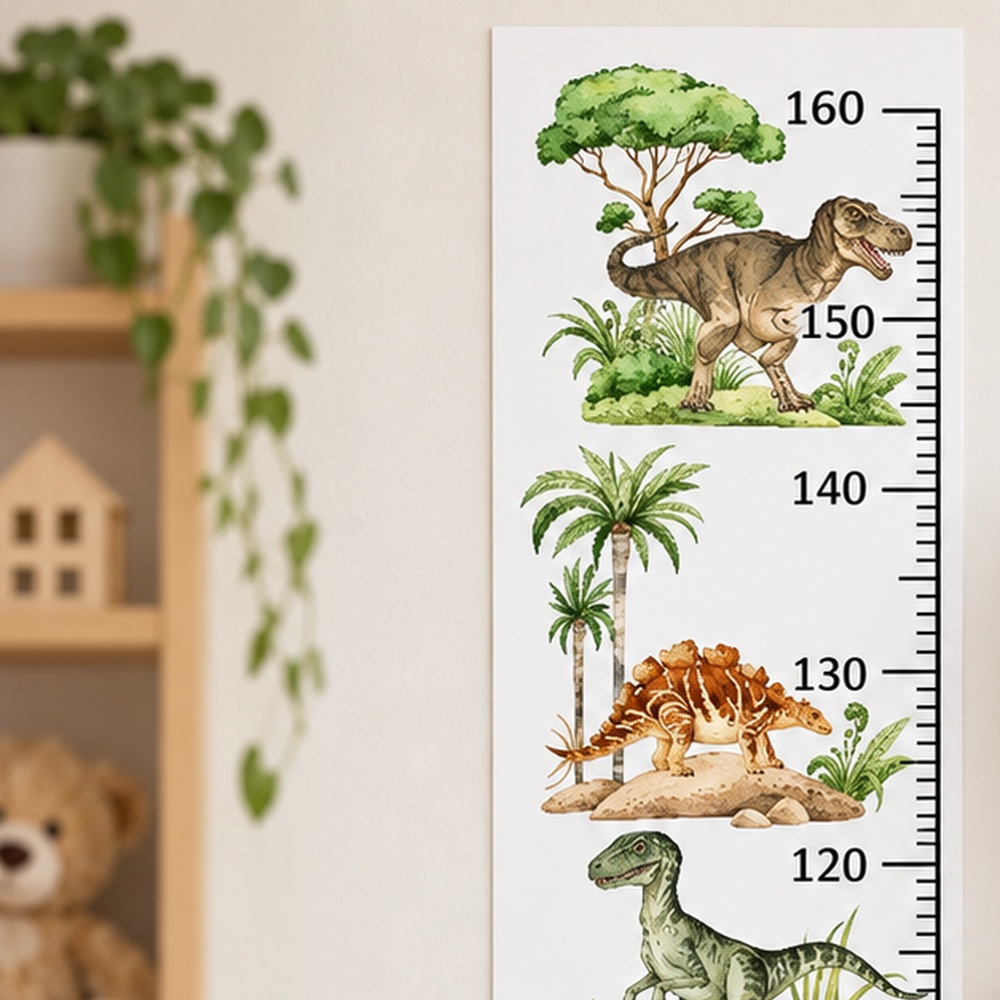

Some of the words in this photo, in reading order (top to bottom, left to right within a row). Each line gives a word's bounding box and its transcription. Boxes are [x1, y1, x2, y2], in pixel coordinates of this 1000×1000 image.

[787, 91, 864, 124] 160
[801, 305, 875, 338] 150
[794, 471, 867, 505] 140
[795, 657, 867, 691] 130
[793, 848, 867, 882] 120
